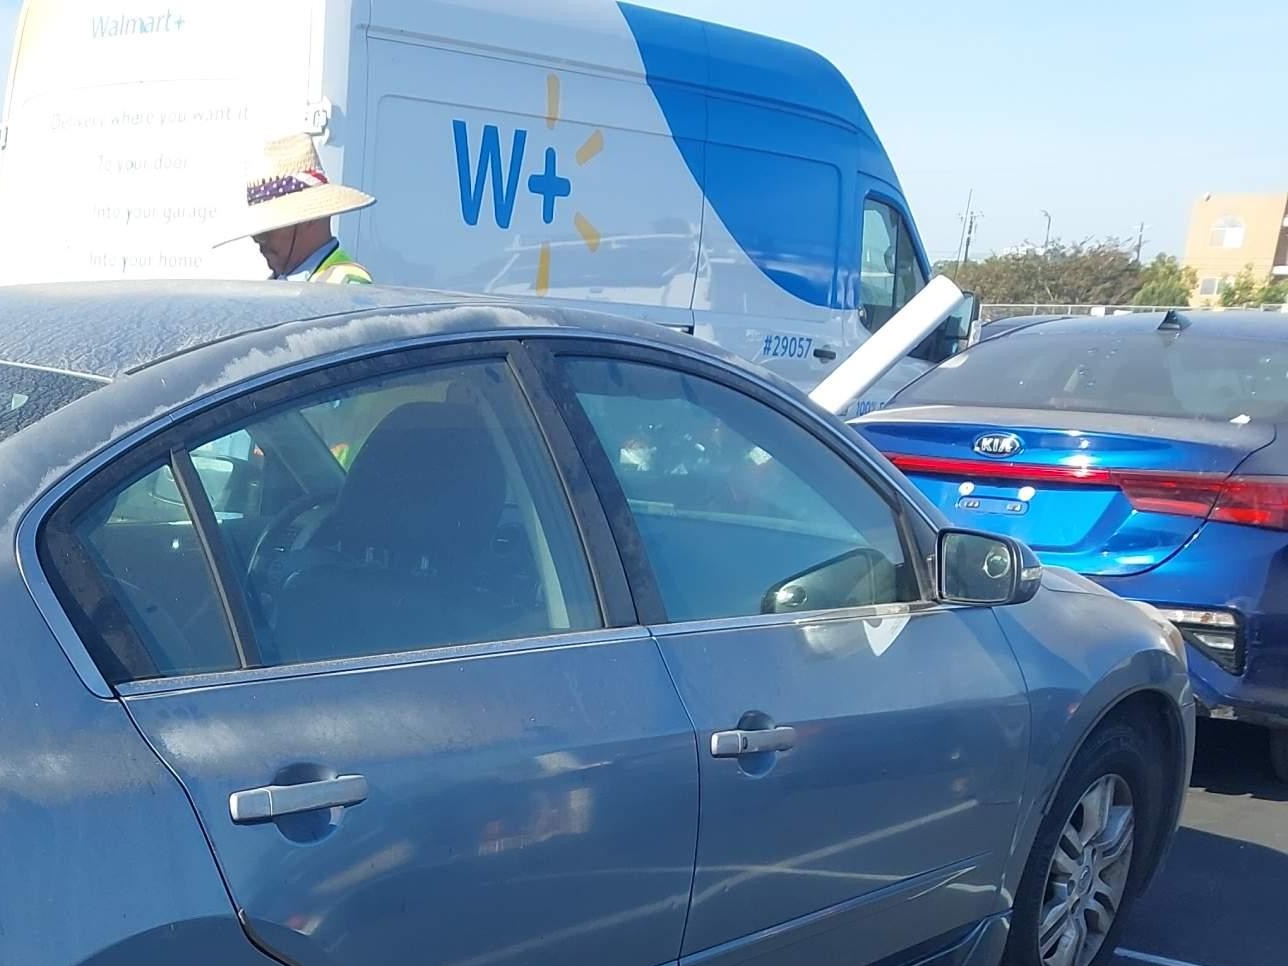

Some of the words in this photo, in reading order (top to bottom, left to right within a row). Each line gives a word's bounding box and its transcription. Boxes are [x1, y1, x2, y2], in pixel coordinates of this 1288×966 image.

[91, 7, 186, 39] Walmart+
[111, 109, 155, 127] where
[160, 110, 187, 128] you
[192, 105, 233, 123] want
[237, 103, 250, 121] it
[115, 158, 148, 176] your
[153, 152, 190, 172] door
[452, 118, 572, 229] W+
[91, 202, 120, 219] Into
[124, 206, 159, 226] your
[162, 206, 218, 224] garage
[88, 249, 116, 268] Into
[120, 255, 154, 274] your
[158, 250, 204, 269] home
[763, 335, 813, 359] #29057
[980, 437, 1014, 453] KIA
